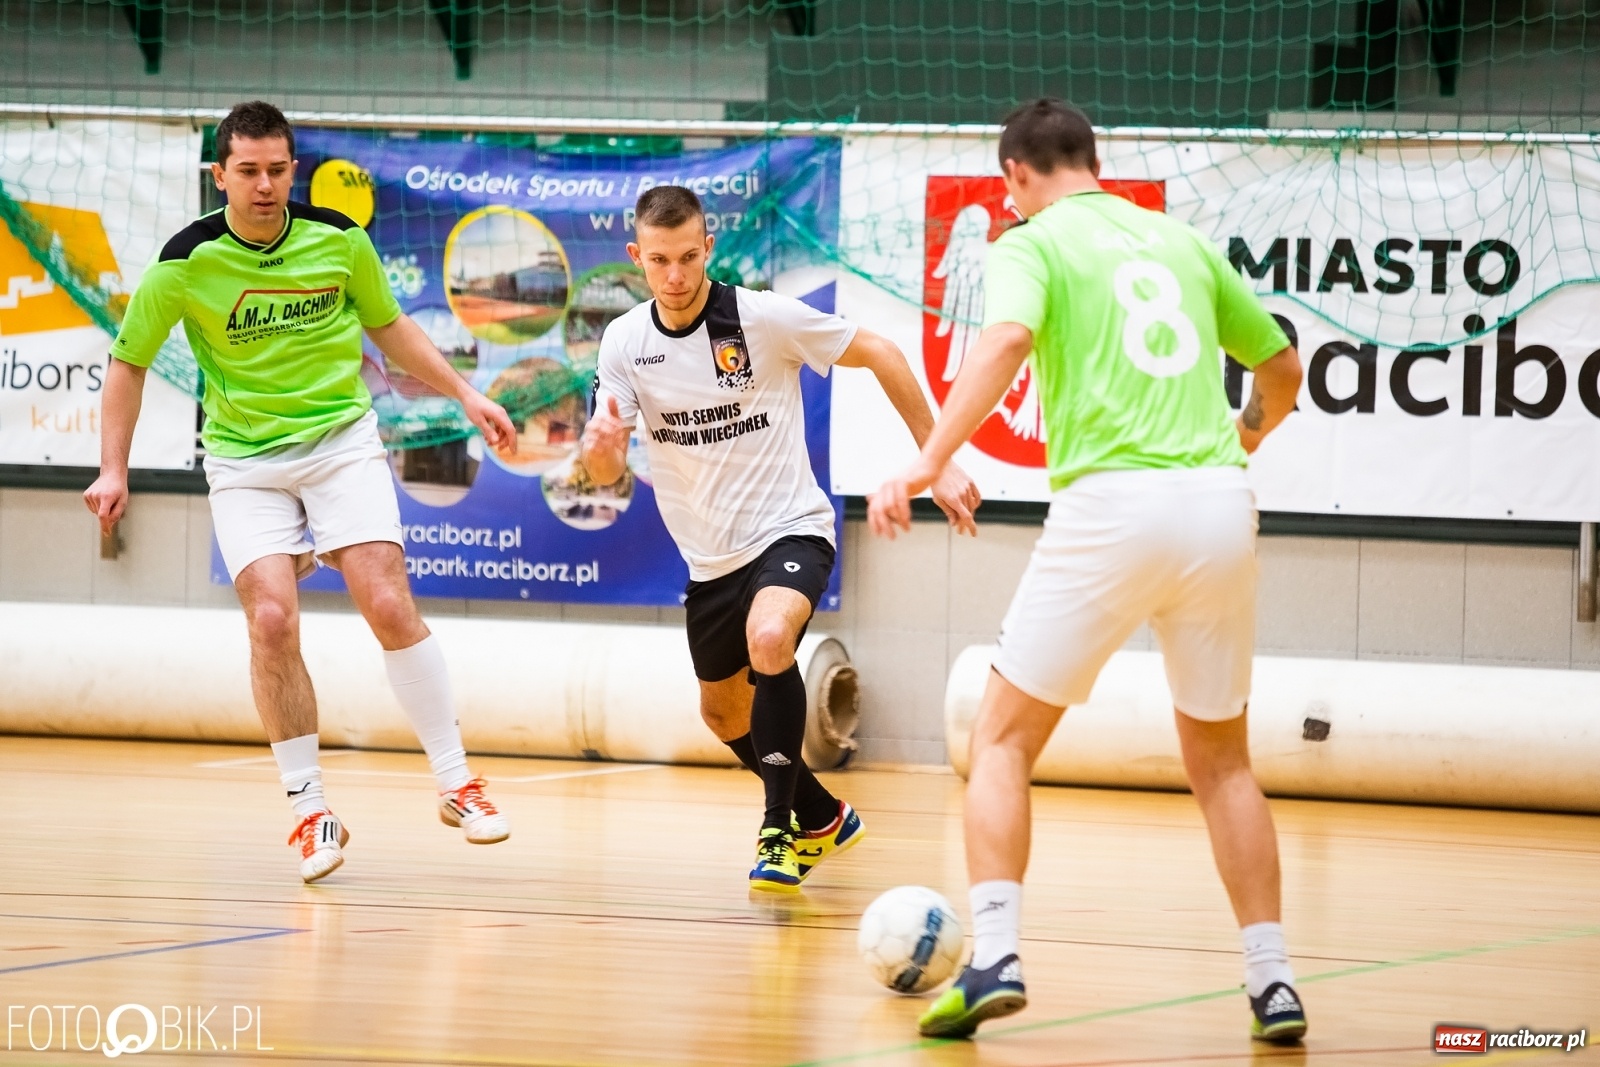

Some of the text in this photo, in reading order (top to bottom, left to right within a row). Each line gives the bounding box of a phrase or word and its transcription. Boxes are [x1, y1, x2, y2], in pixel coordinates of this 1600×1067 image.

[405, 165, 520, 195] Ośrodek
[527, 174, 614, 199] Sportu
[620, 176, 631, 197] i
[589, 212, 614, 230] w
[258, 257, 284, 269] JAKO
[1228, 237, 1521, 297] MIASTO
[225, 303, 277, 332] A.M.J.
[1113, 259, 1200, 378] 8
[1, 350, 112, 392] ibors
[642, 354, 666, 366] VIGO
[660, 402, 742, 427] AUTO-SERWIS
[700, 412, 771, 446] WIECZOREK
